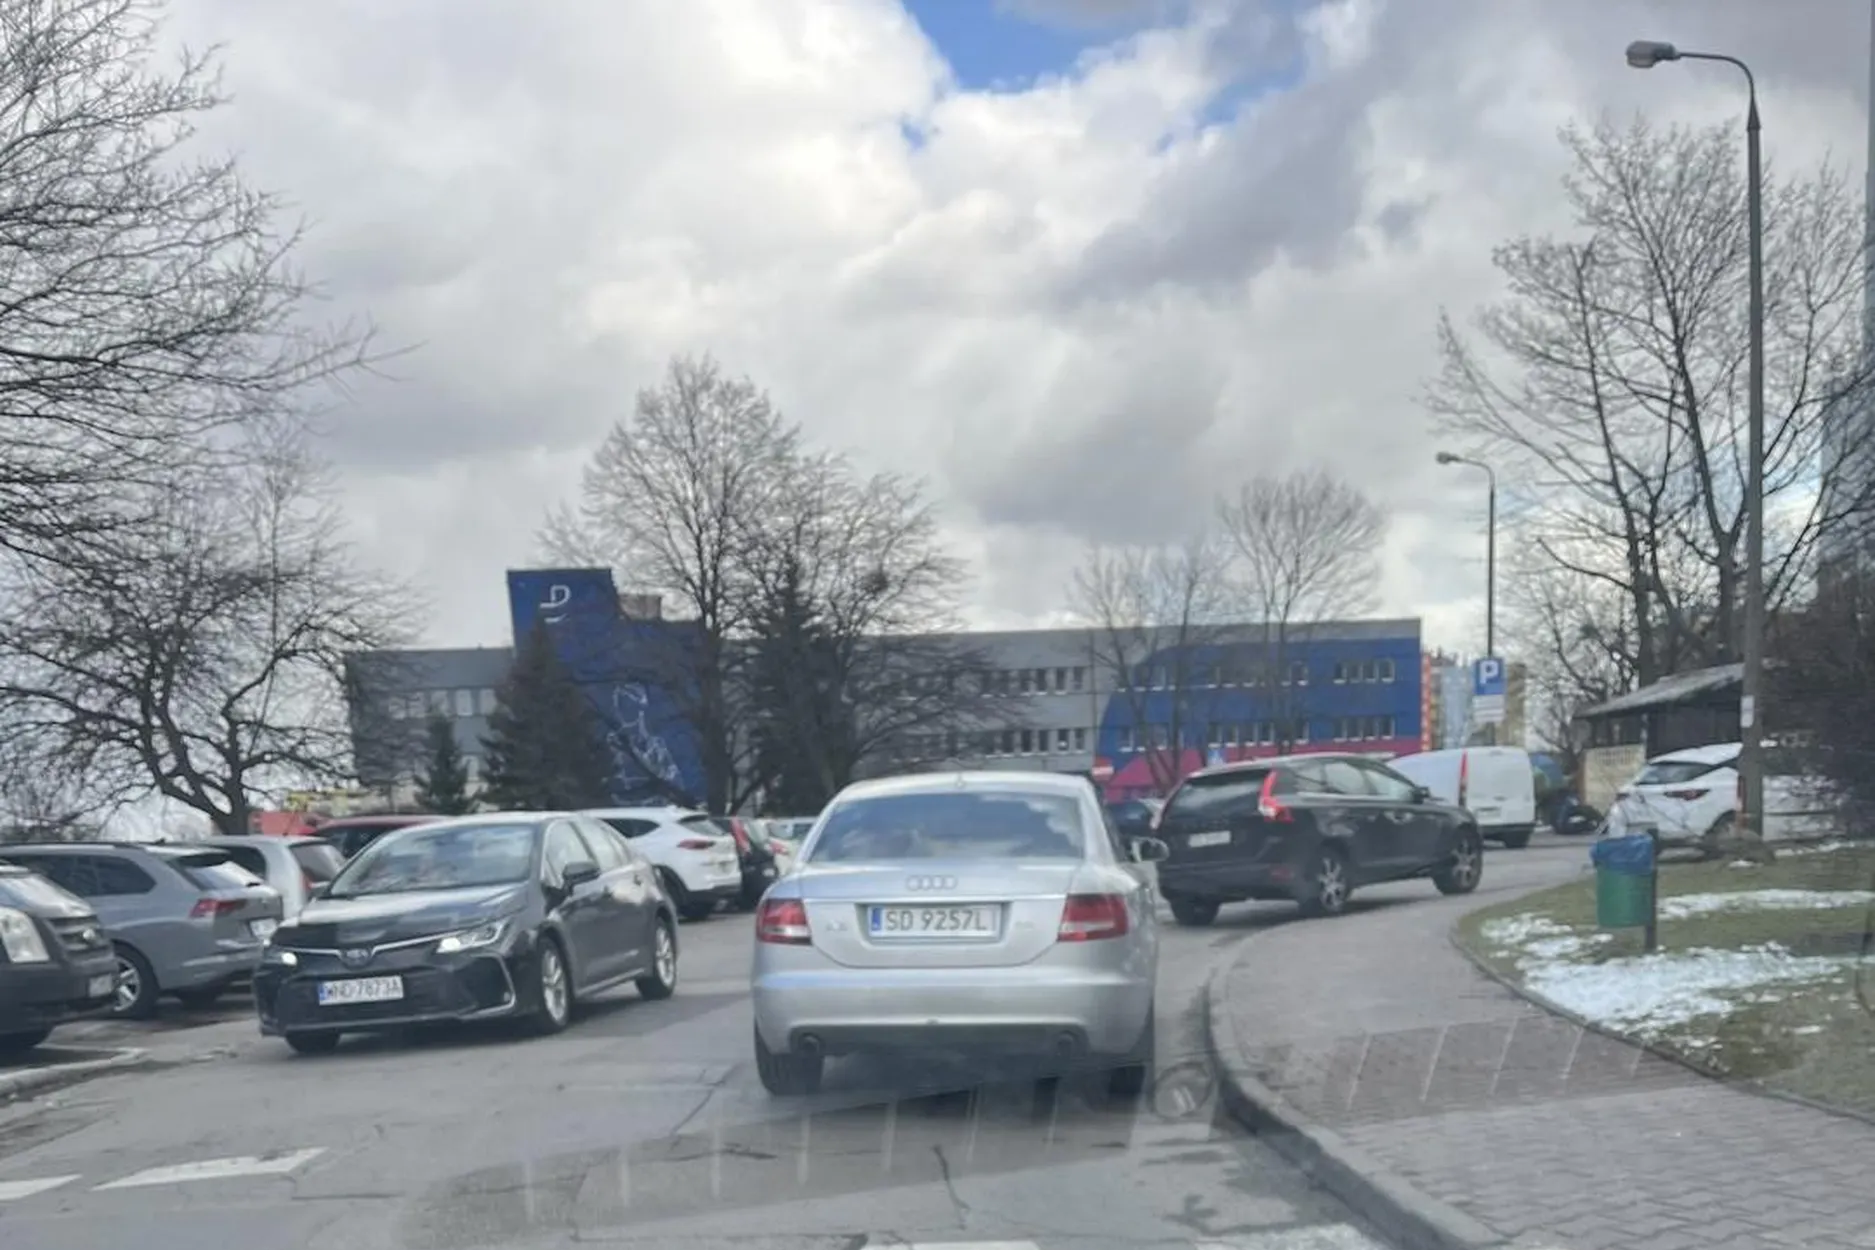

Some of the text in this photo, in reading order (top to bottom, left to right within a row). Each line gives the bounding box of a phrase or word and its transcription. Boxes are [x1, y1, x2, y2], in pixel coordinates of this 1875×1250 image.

[1480, 660, 1499, 684] P
[885, 910, 988, 931] SD 9257L
